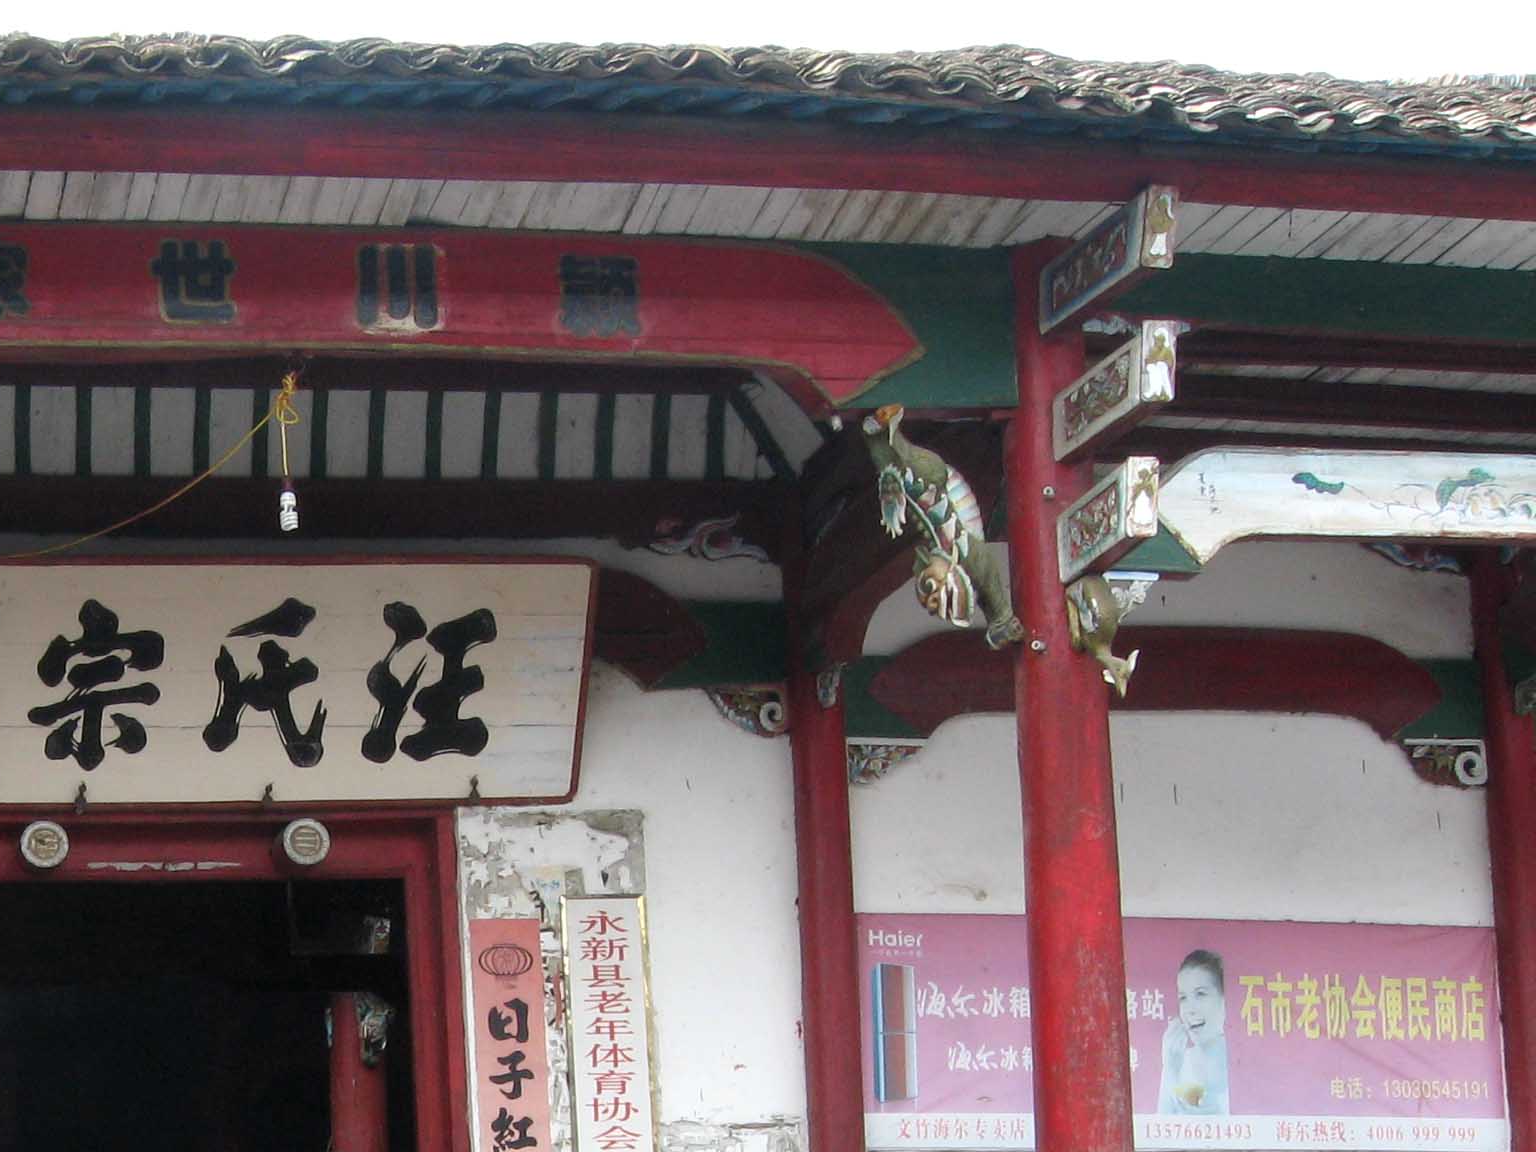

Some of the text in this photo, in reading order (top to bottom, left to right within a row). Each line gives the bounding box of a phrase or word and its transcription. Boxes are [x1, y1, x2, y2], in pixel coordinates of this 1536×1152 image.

[868, 929, 924, 948] Haier
[1238, 974, 1487, 1042] 石市老协会便民商店
[1383, 1079, 1490, 1100] 13030545191
[896, 1118, 1027, 1141] 文竹海尔专卖店
[1145, 1123, 1253, 1141] 13576621493
[1366, 1125, 1405, 1142] 4006
[1412, 1126, 1441, 1143] 999
[1448, 1126, 1477, 1143] 999
